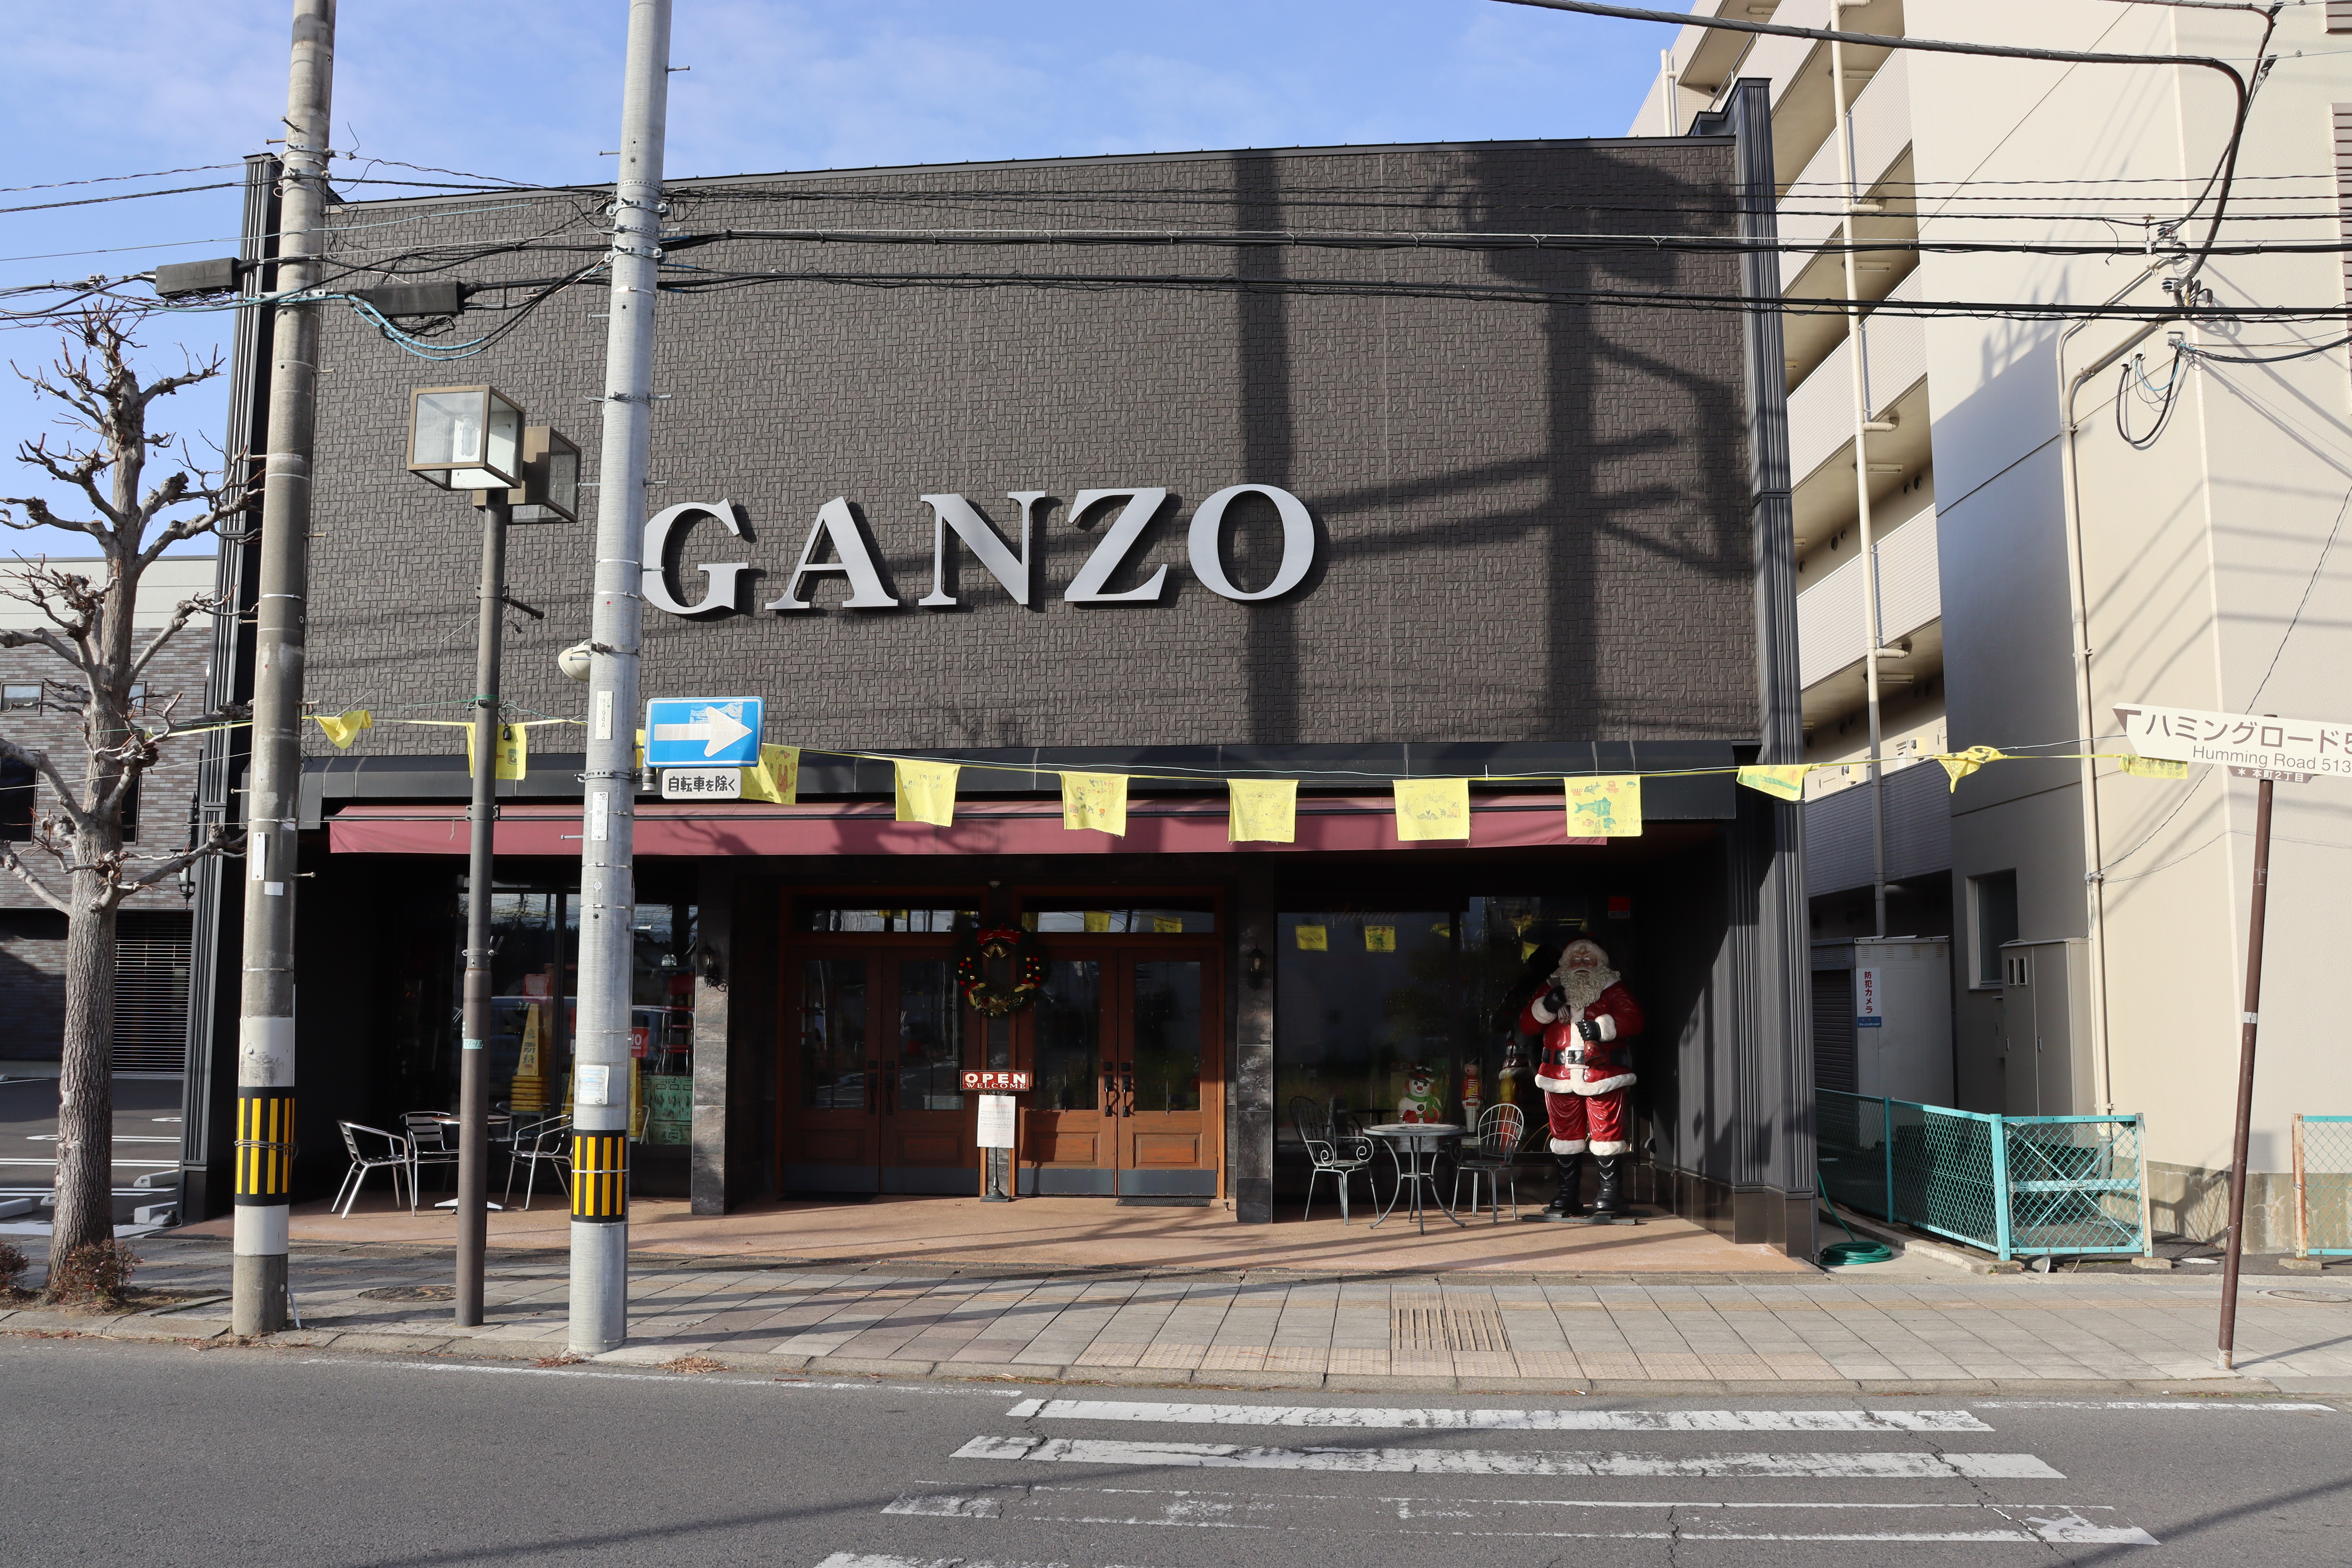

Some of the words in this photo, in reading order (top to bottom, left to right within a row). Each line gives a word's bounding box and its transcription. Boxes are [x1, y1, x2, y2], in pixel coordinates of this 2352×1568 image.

[642, 484, 1315, 615] GANZO
[2192, 745, 2268, 768] Humming
[2274, 753, 2316, 769] Road
[2321, 758, 2351, 773] 513
[668, 775, 735, 793] 自転車を除く
[2252, 768, 2304, 783] 本町2丁目
[1864, 971, 1873, 1014] 防犯カメラ
[965, 1073, 1026, 1084] OPEN
